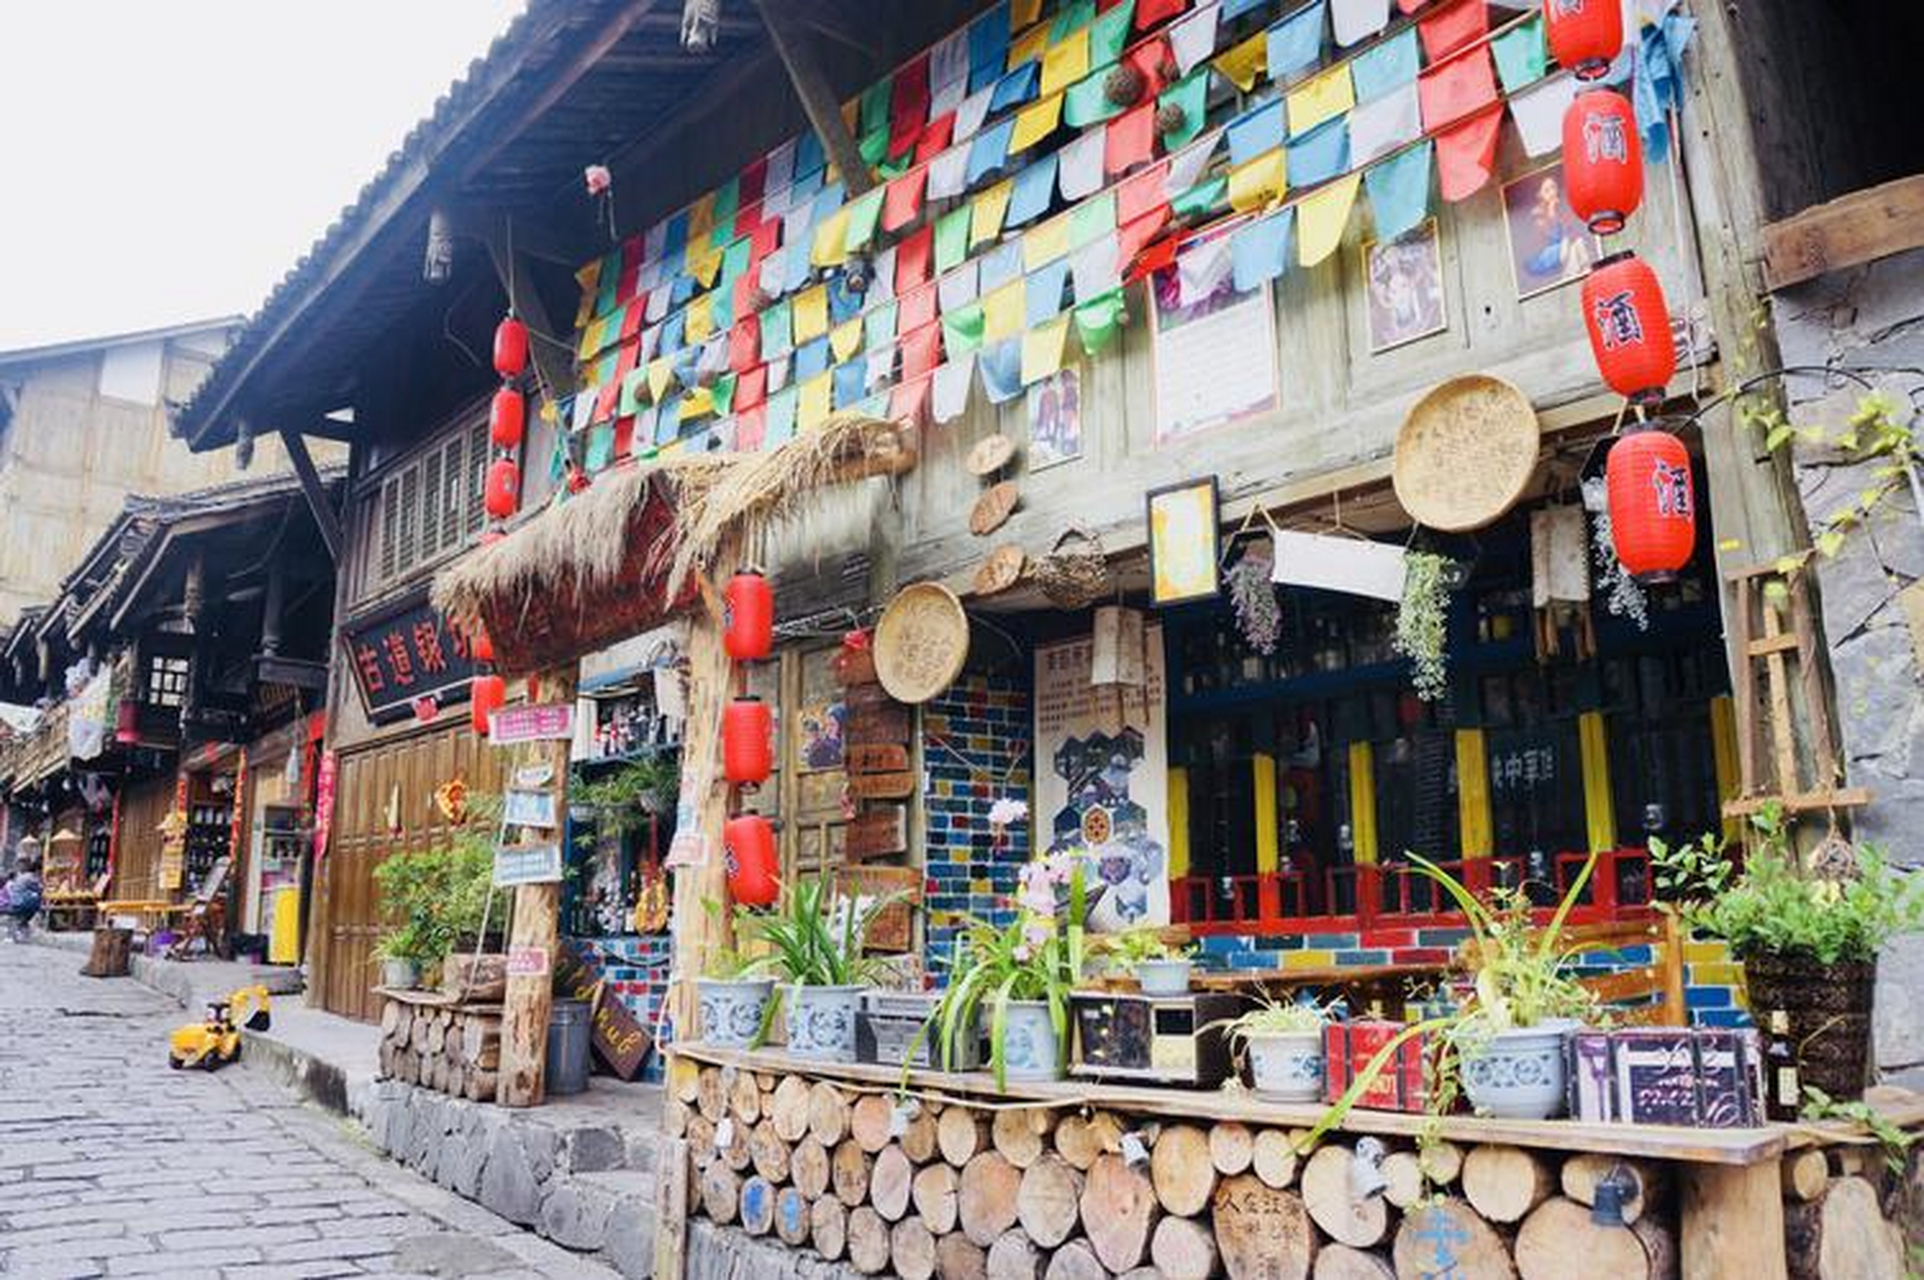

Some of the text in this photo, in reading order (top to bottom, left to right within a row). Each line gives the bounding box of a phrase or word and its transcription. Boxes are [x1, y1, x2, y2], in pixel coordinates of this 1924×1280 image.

[1583, 112, 1627, 164] 酒
[1596, 290, 1645, 350] 酒
[1653, 457, 1693, 525] 酒
